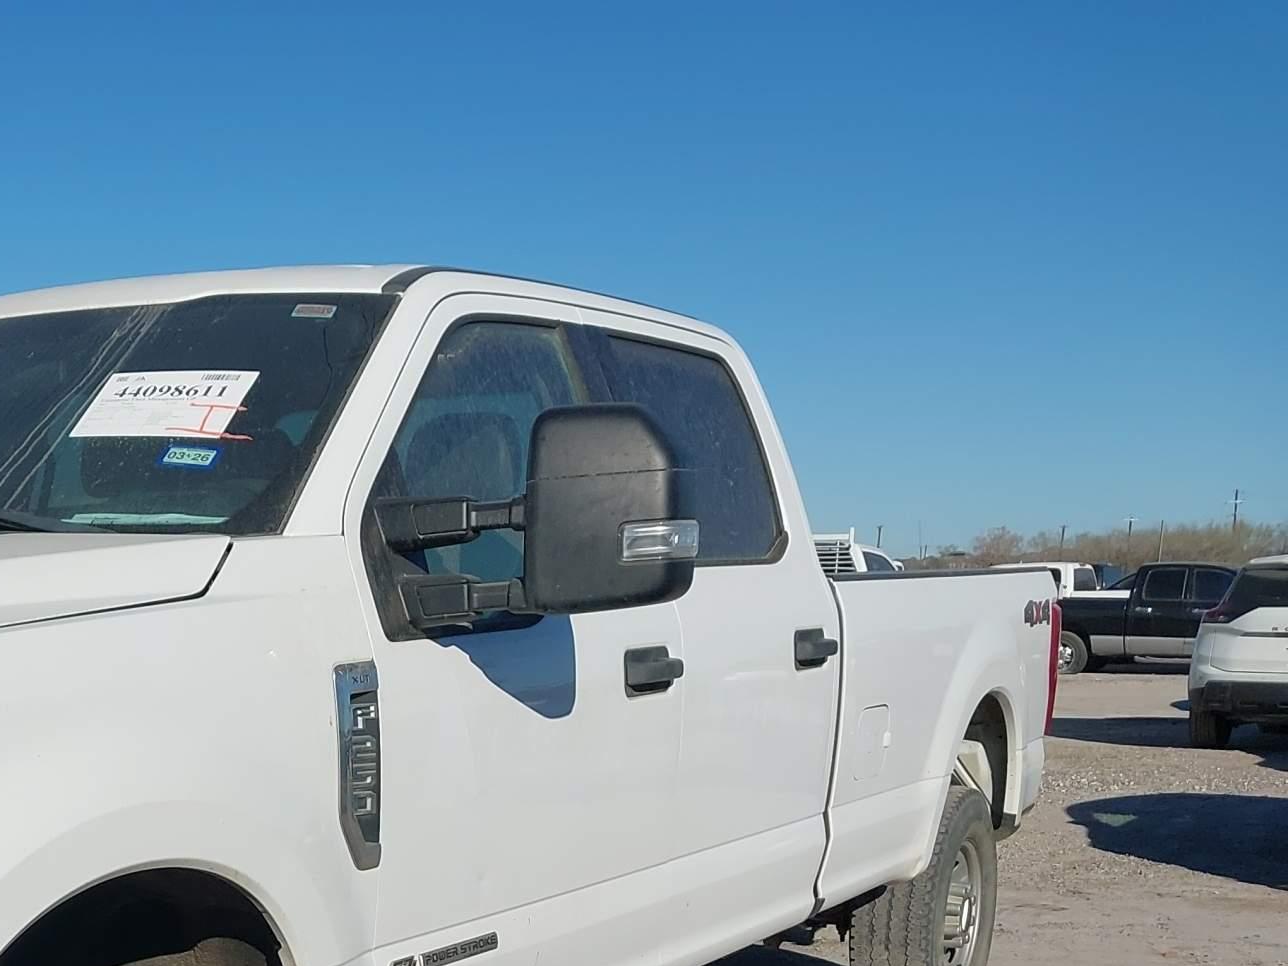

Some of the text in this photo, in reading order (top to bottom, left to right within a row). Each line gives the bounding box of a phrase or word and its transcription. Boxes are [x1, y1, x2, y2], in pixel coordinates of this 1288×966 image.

[113, 385, 228, 398] 44098611
[351, 674, 370, 685] XLT
[424, 947, 458, 966] POWER
[459, 934, 497, 954] STROKE
